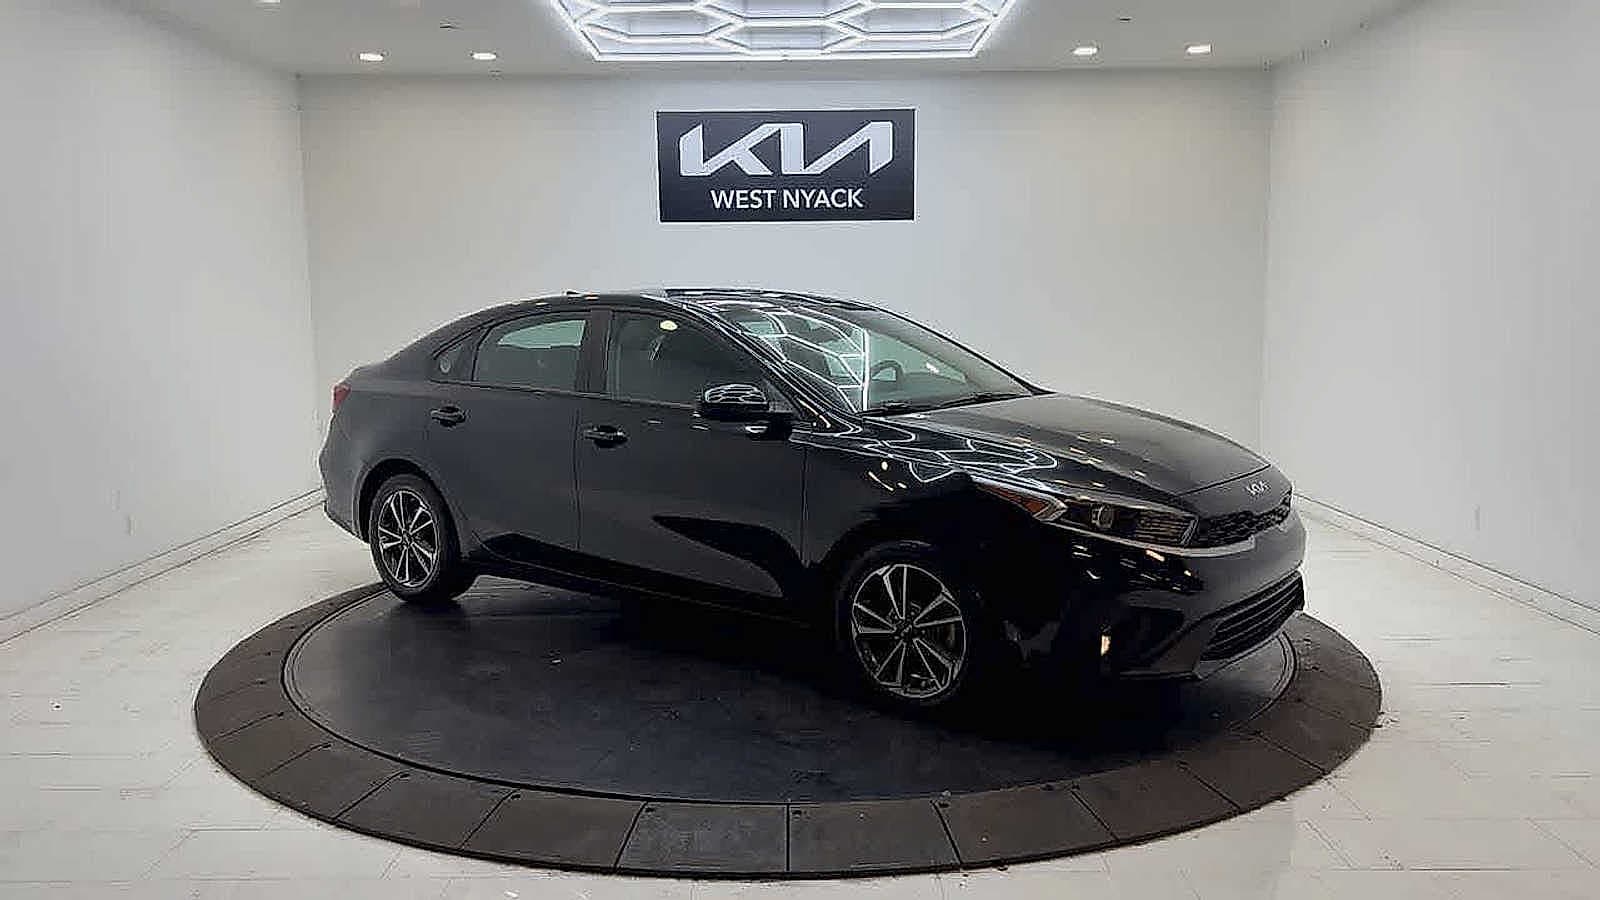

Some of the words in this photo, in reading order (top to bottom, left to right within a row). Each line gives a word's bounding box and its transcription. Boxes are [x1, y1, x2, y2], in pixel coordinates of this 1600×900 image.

[679, 121, 894, 176] KIA
[711, 189, 777, 208] WEST
[783, 188, 864, 208] NYACK
